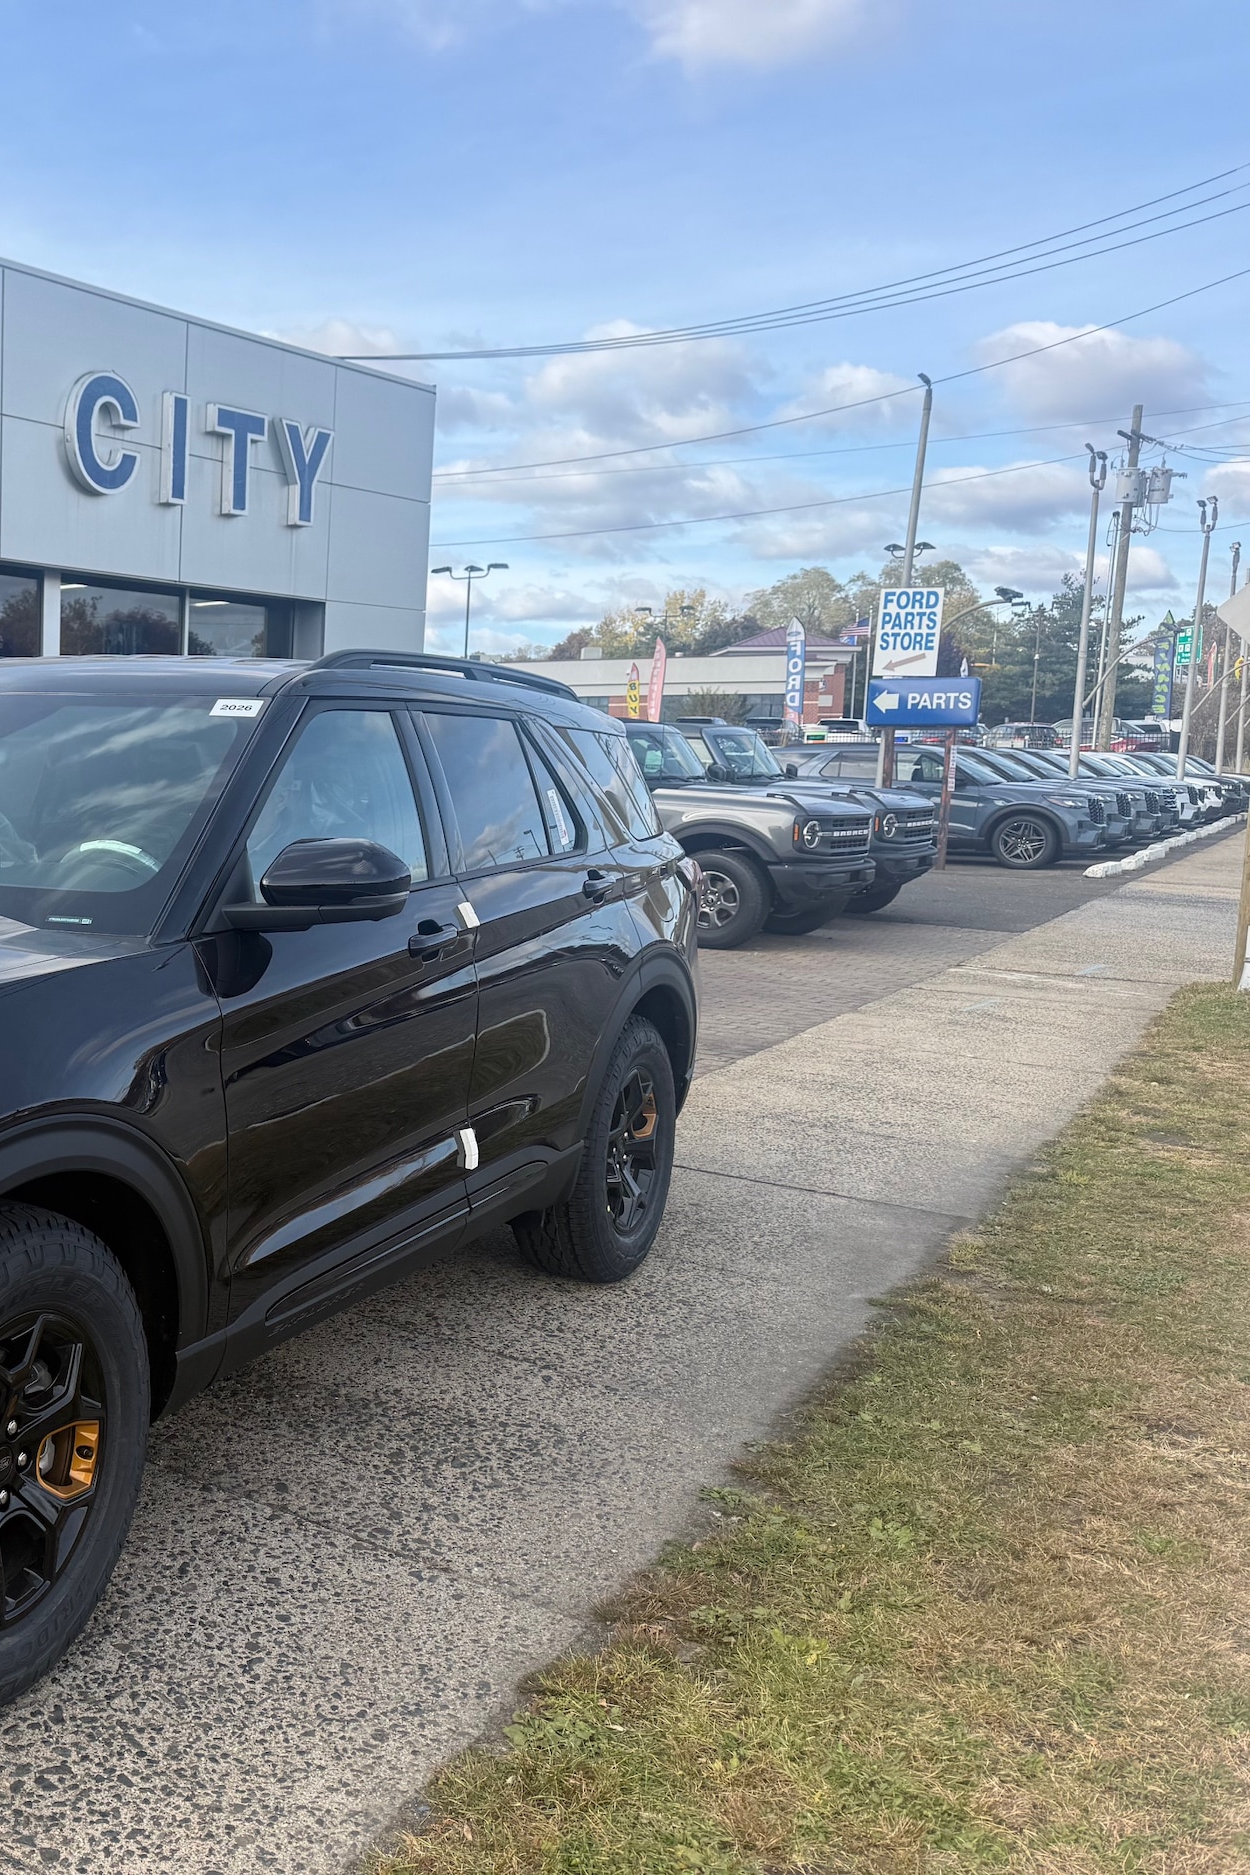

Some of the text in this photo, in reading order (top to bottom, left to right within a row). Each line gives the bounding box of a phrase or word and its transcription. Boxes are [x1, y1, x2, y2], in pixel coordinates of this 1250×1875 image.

[64, 369, 335, 528] CITY
[883, 591, 939, 610] FORD
[881, 611, 937, 630] PARTS
[879, 632, 935, 651] STORE
[907, 692, 972, 710] PARTS
